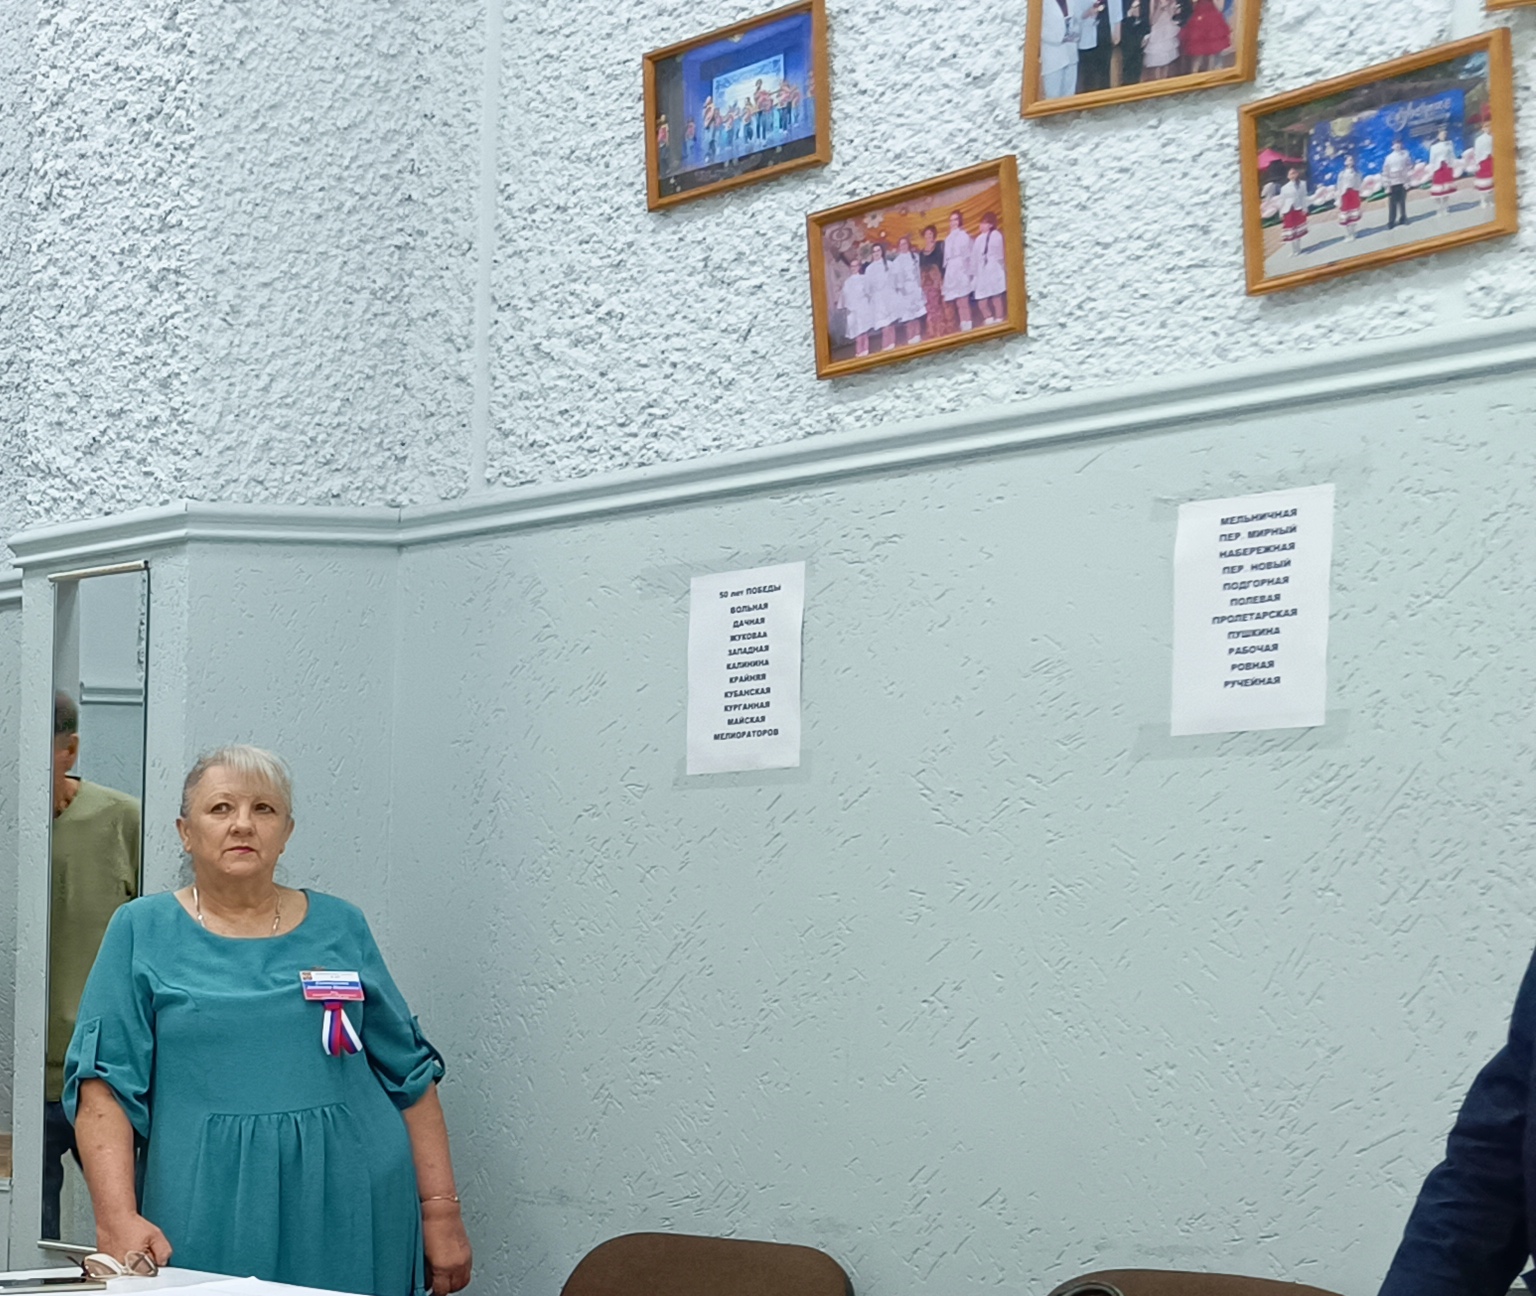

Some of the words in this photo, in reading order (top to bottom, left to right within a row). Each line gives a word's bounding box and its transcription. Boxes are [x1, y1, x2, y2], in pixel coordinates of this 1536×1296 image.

[1220, 508, 1297, 526] МЕЛЬНИЧНАЯ
[1247, 524, 1297, 538] МИРНЫЙ
[1219, 542, 1295, 558] НАБЕРЕЖНАЯ
[1250, 558, 1291, 571] НОВЫЙ
[1222, 575, 1289, 591] ПОДГОРНАЯ
[719, 591, 728, 599] 50
[746, 584, 781, 595] ПОБЕДЫ
[1230, 593, 1281, 606] ПОЛЕВАЯ
[730, 602, 768, 614] ВОЛЬНАЯ
[1212, 608, 1298, 624] ПРОЛЕТАРСКАЯ
[733, 617, 765, 628] ДАЧНАЯ
[1227, 627, 1280, 639] ПУШКИНА
[728, 645, 769, 656] ЗАПАДНАЯ
[1228, 643, 1279, 655] РАБОЧАЯ
[726, 659, 769, 670] КАЛИНИНА
[1231, 660, 1274, 671] РОВНАЯ
[729, 673, 766, 683] КРАЙНЯЯ
[1223, 676, 1281, 688] РУЧЕЙНАЯ
[724, 687, 771, 698] КУБАНСКАЯ
[724, 701, 770, 712] КУРГАННАЯ
[727, 715, 766, 725] МАЙСКАЯ
[713, 728, 779, 740] МЕЛИОРАТОРОВ
